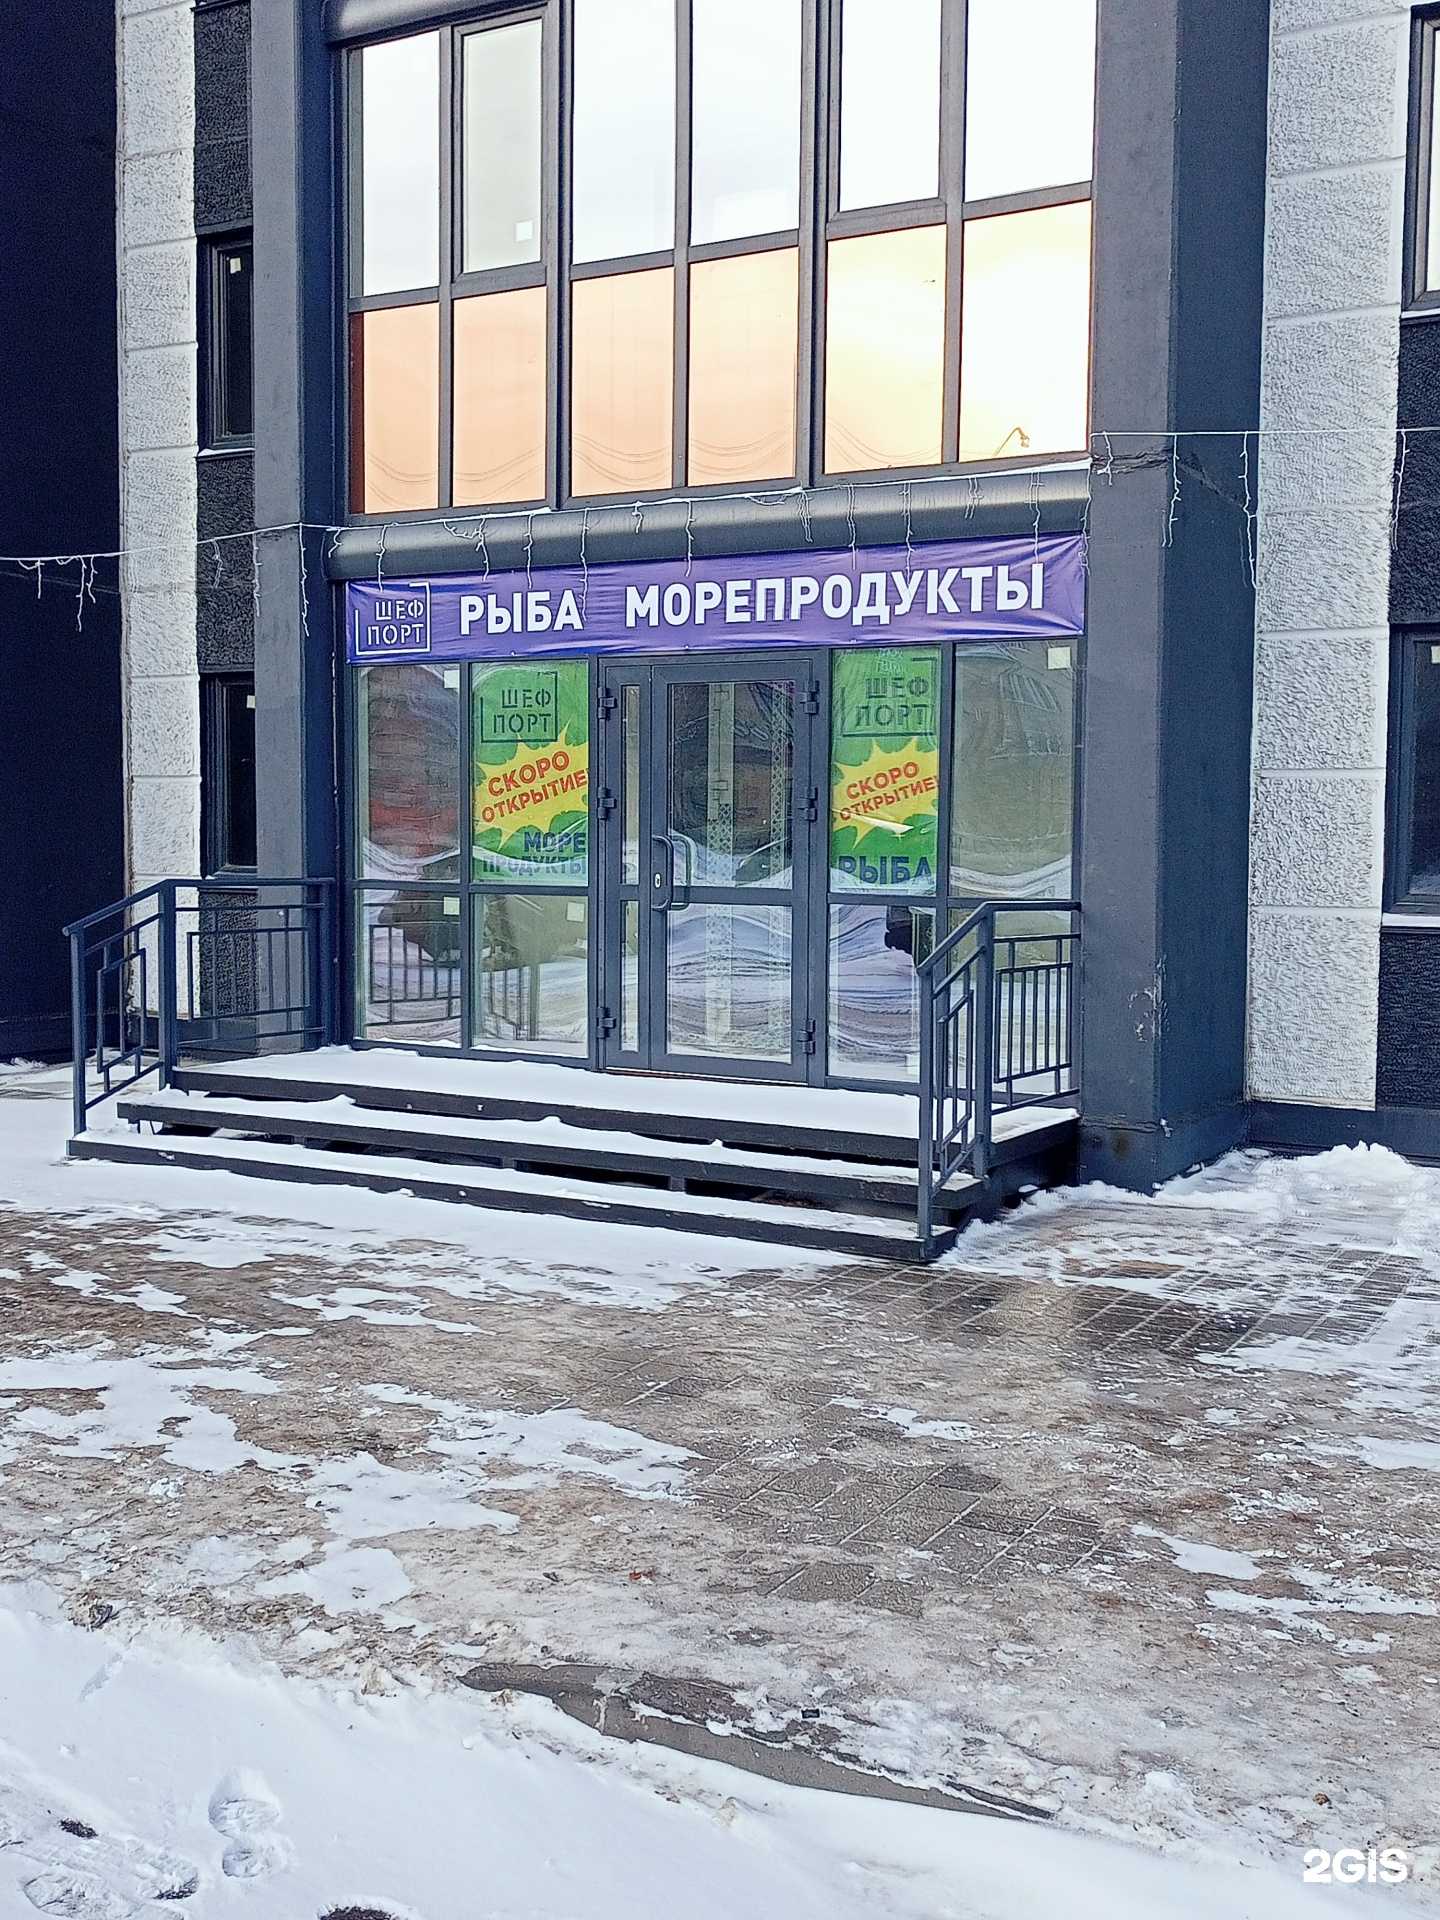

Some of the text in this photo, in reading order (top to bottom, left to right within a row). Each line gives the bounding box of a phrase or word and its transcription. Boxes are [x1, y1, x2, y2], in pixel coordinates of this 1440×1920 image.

[374, 598, 424, 621] ШЕФ
[460, 563, 1044, 636] РЫБА МОРЕПРОДУКТЫ
[366, 623, 425, 646] ПОРТ
[501, 688, 551, 708] ШЕФ
[865, 676, 929, 698] ШЕФ
[493, 713, 552, 734] ПОРТ
[855, 704, 929, 727] ПОРТ
[487, 750, 570, 797] СКОРО
[846, 761, 920, 800] СКОРО
[481, 768, 590, 823] ОТКРЫТИЕ
[524, 831, 586, 853] МОРЕ
[838, 856, 932, 885] РЫБА
